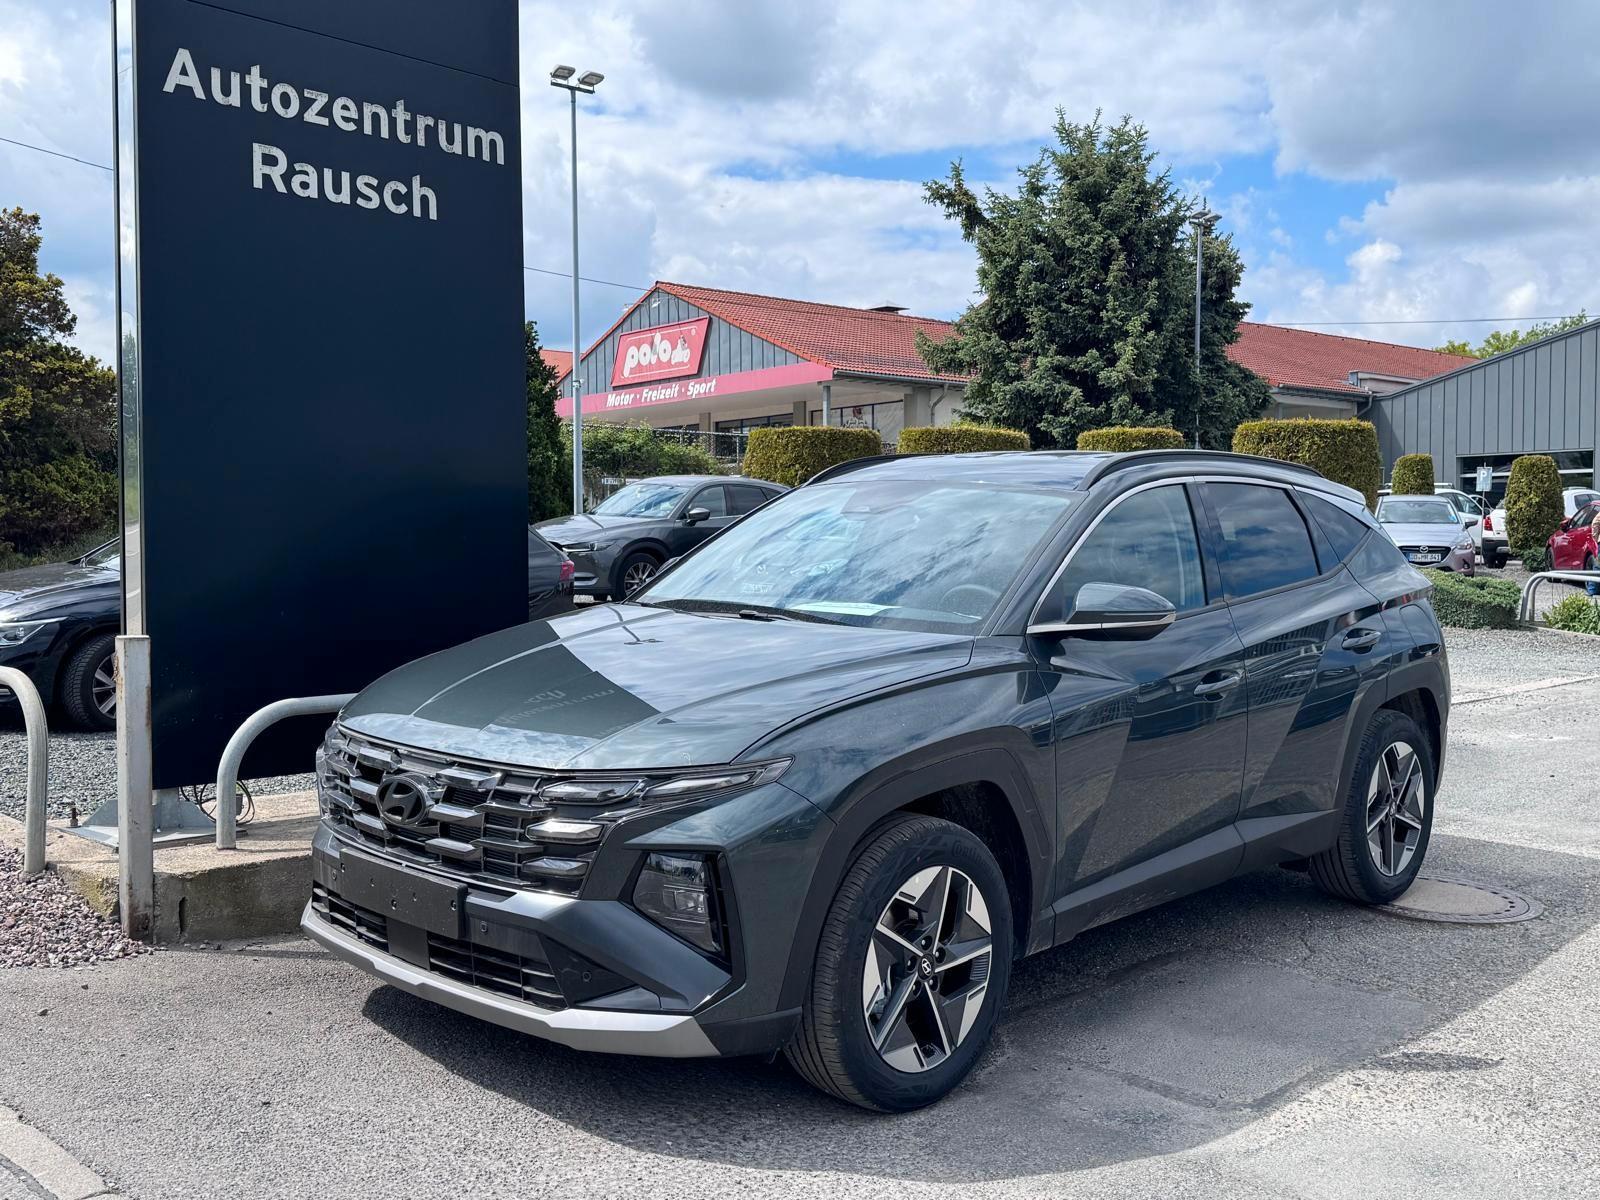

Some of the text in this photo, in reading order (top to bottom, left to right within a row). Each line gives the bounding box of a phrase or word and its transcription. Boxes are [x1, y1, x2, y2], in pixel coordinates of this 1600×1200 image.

[162, 48, 505, 165] Autozentrum
[252, 142, 438, 220] Rausch
[606, 379, 716, 408] Motor Freizeit Sport
